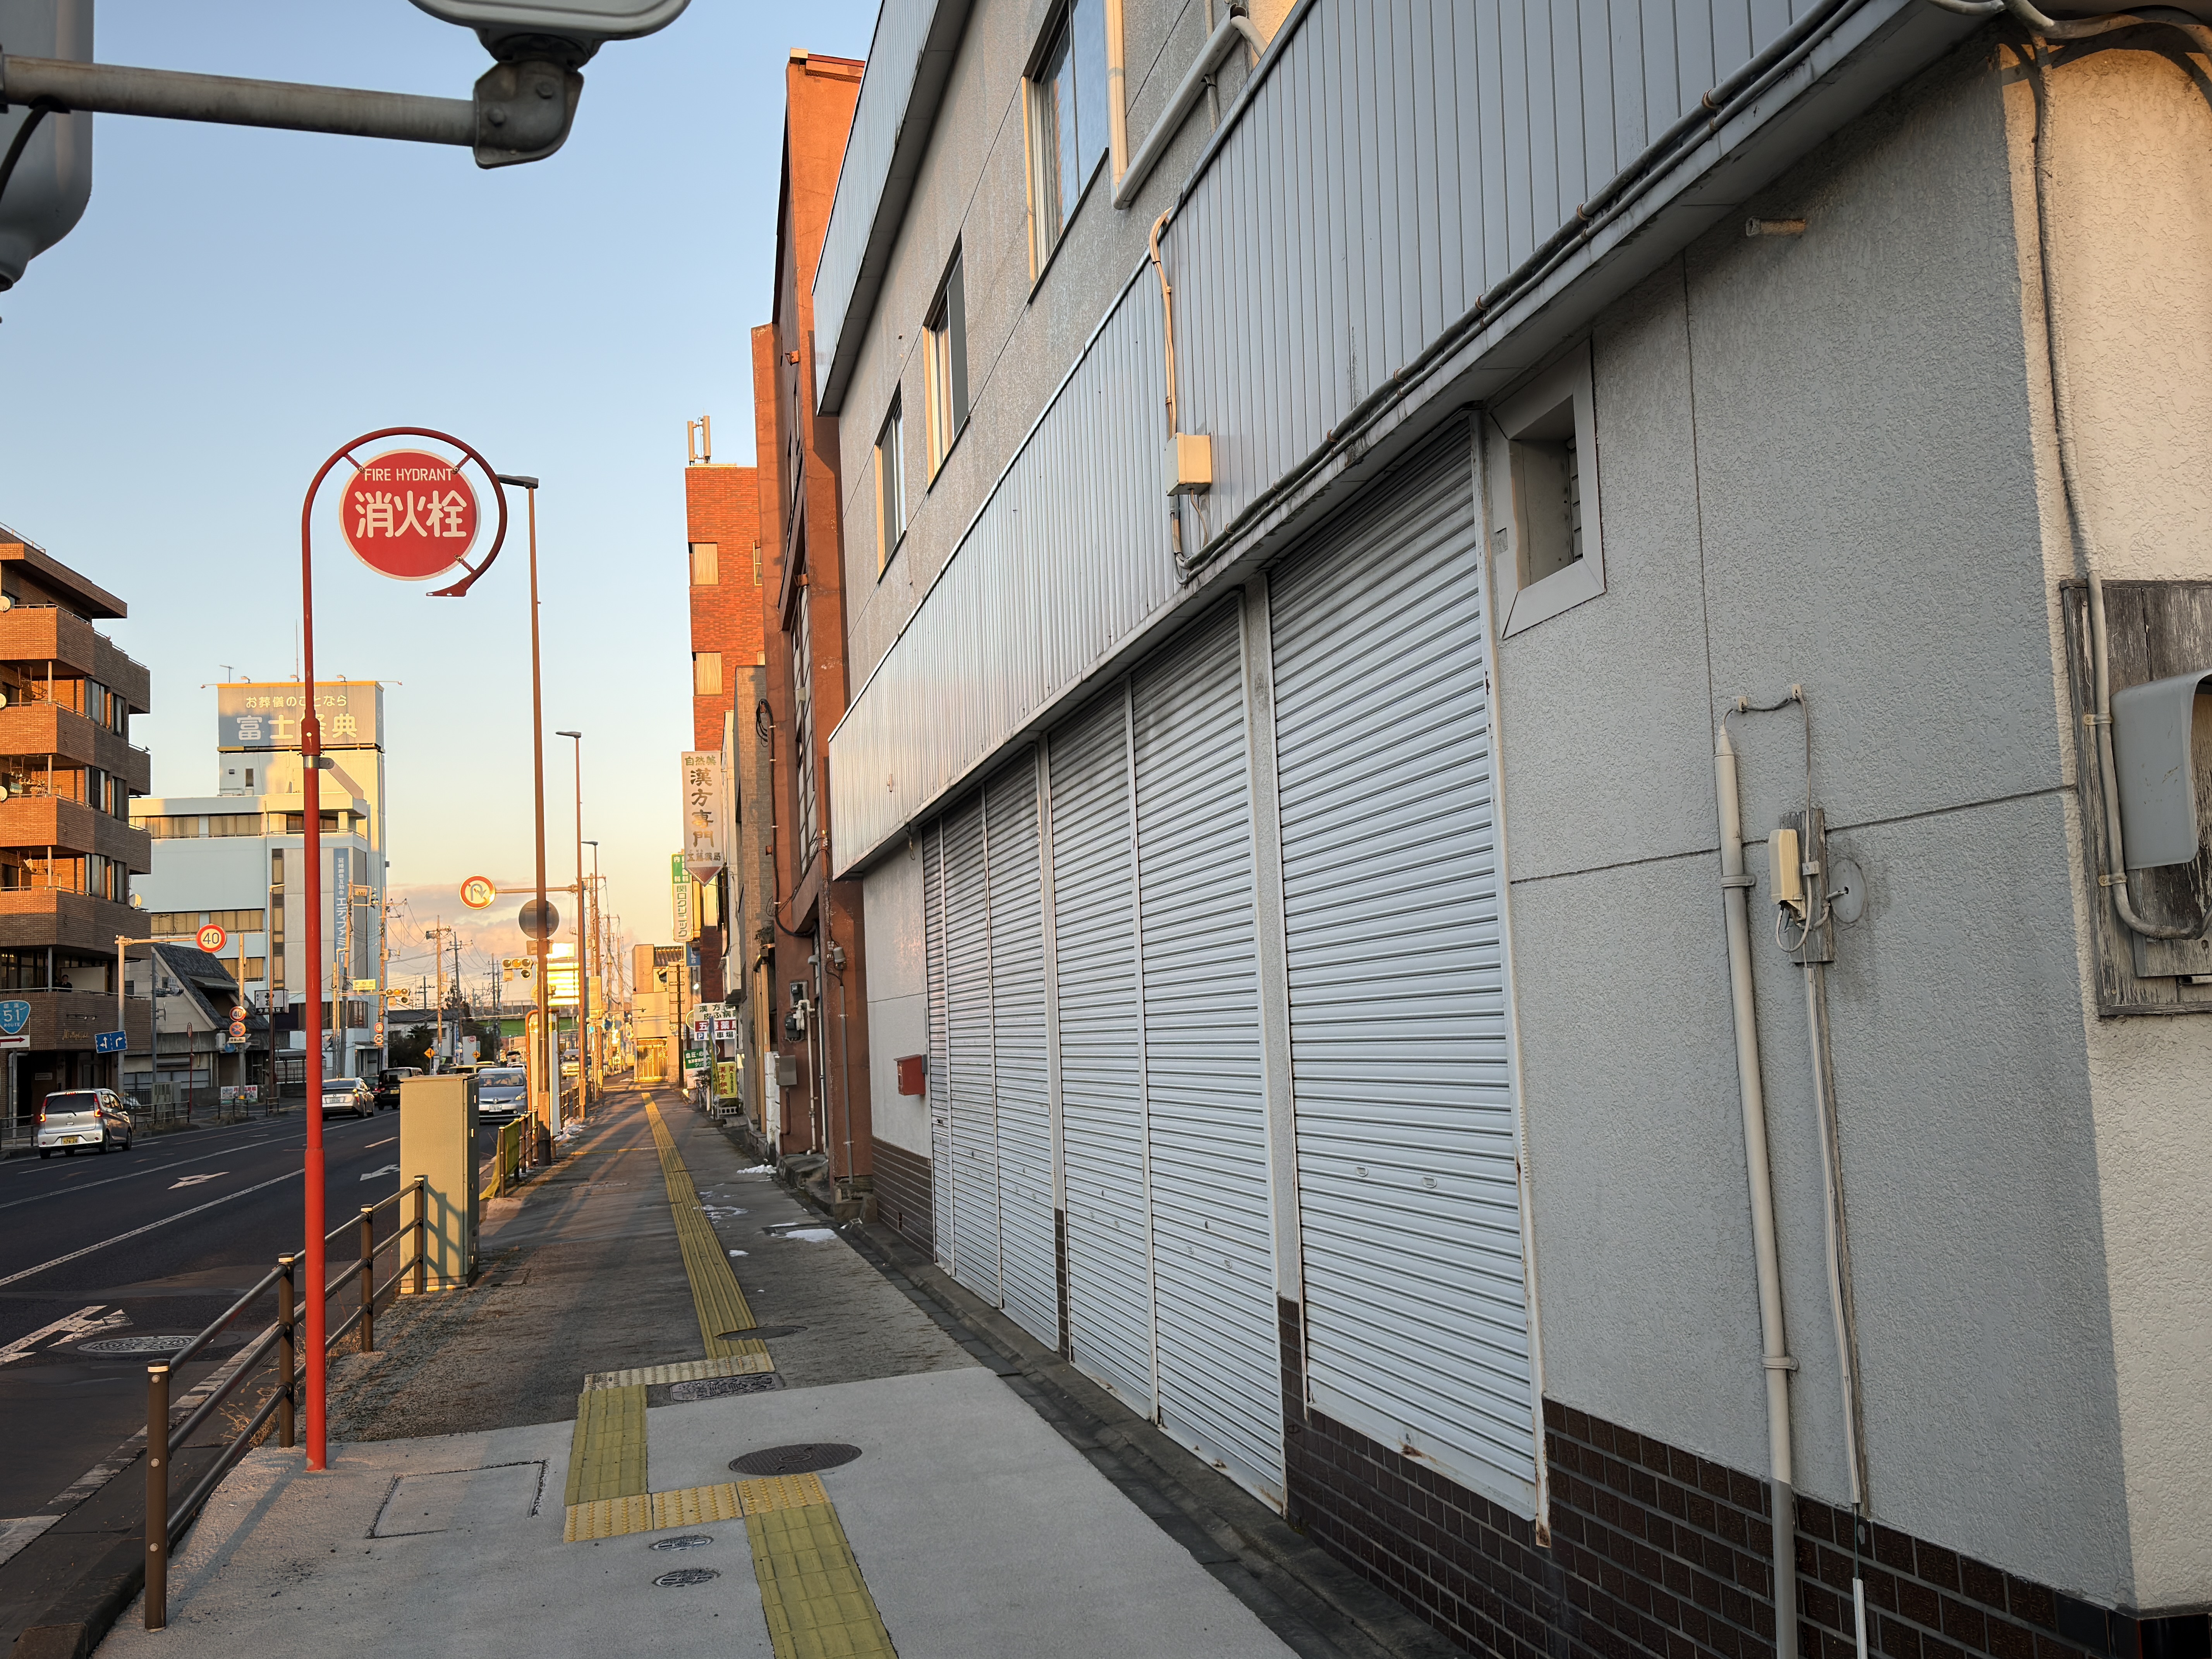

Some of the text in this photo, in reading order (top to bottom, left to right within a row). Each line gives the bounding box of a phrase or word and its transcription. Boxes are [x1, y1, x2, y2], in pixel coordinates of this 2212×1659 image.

[364, 469, 452, 481] FIRE HYDRANT
[354, 490, 467, 538] 消火栓
[690, 768, 714, 848] 漢方専門
[203, 933, 220, 944] 40
[3, 1009, 19, 1022] 51
